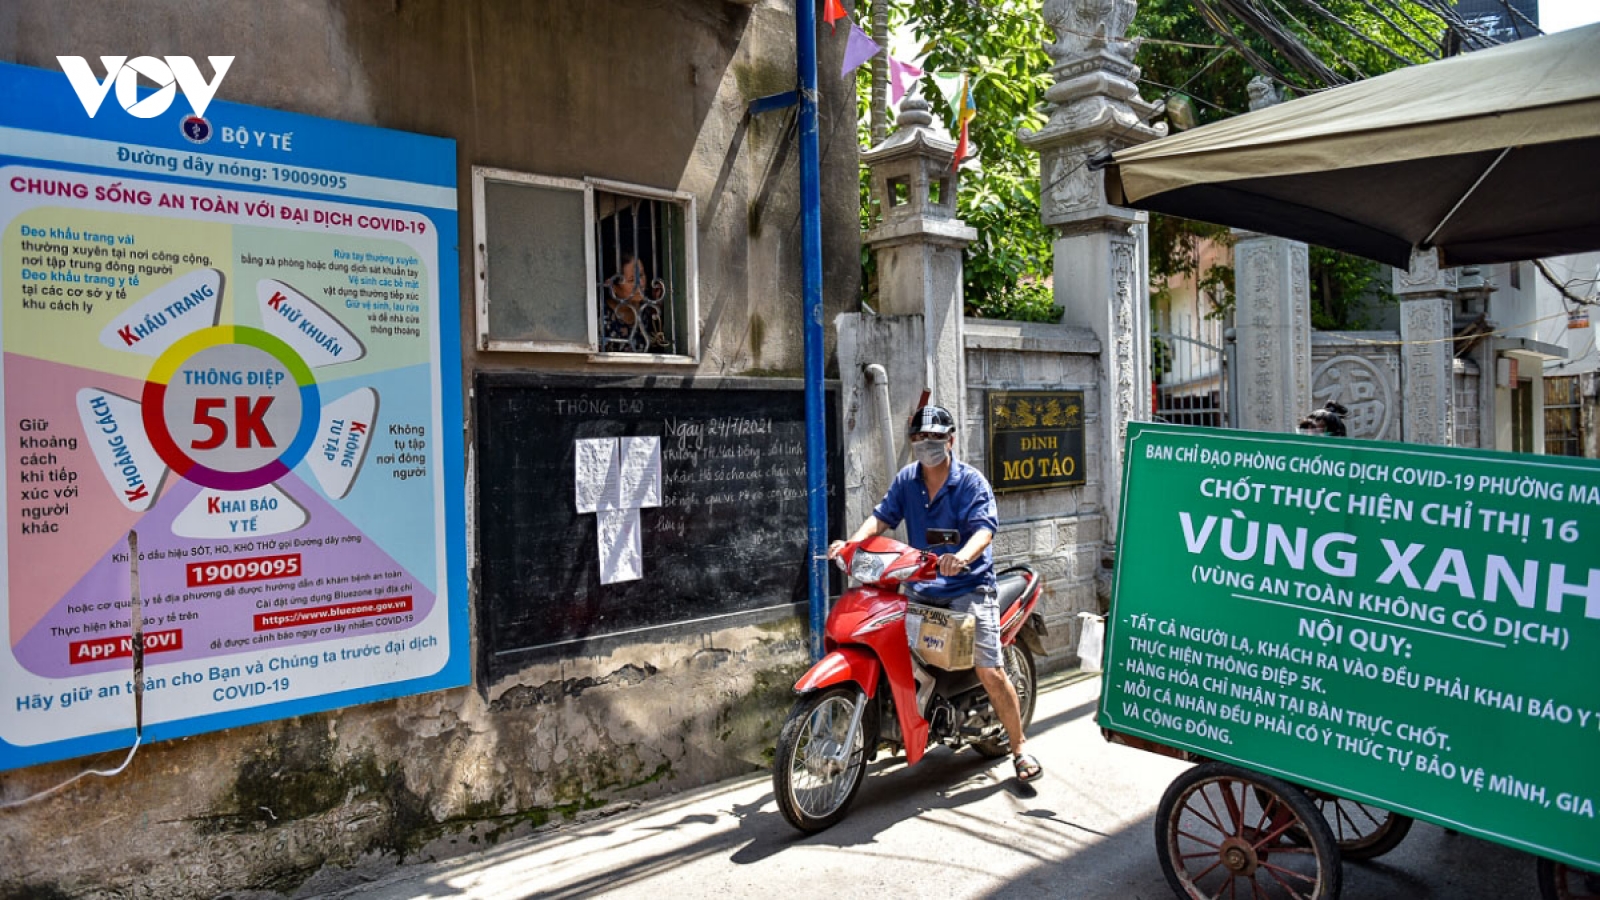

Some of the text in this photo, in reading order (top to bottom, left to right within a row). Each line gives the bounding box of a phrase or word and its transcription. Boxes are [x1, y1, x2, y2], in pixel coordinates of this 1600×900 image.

[222, 126, 292, 151] BỘ Y TẾ
[116, 146, 347, 189] Đường dây nóng: 19009095
[10, 176, 426, 234] CHUNG SỐNG AN TOÀN VỚI ĐẠI DỊCH COVID-19
[21, 225, 46, 238] Đeo
[50, 228, 80, 240] khẩu
[83, 232, 114, 246] trang
[21, 240, 212, 266] thường xuyên tại nơi công cộng,
[22, 256, 43, 266] nơi
[46, 257, 66, 270] tập
[69, 258, 102, 272] trung
[138, 265, 172, 276] người
[21, 269, 139, 288] Đeo khẩu trang y tế
[117, 284, 214, 347] KHẨU TRANG
[267, 291, 343, 357] KHỬ KHUẨN
[183, 368, 285, 390] THÔNG ĐIỆP
[19, 419, 49, 431] Giữ
[191, 396, 277, 450] 5K
[19, 435, 77, 449] khoảng
[89, 396, 149, 502] KHOẢNG CÁCH
[341, 421, 367, 468] KHÔNG
[1020, 435, 1057, 451] ĐÌNH
[20, 452, 57, 465] cách
[1003, 451, 1075, 481] MƠ TÁO
[21, 466, 77, 483] khi tiếp
[1146, 444, 1173, 460] BAN
[1175, 444, 1198, 463] CHỈ
[1200, 448, 1231, 469] ĐẠO
[1234, 451, 1286, 471] PHÒNG
[1289, 454, 1345, 477] CHỐNG
[1349, 463, 1389, 484] DỊCH
[1392, 467, 1475, 491] COVID-19
[1479, 476, 1563, 501] PHƯỜNG
[21, 486, 78, 500] xúc với
[207, 494, 278, 514] KHAI BÁO
[22, 503, 69, 520] người
[1200, 476, 1578, 542] CHỐT THỰC HIỆN CHỈ THỊ 16
[22, 521, 59, 534] khác
[228, 515, 258, 532] Y TẾ
[192, 558, 298, 583] 19009095
[1179, 509, 1600, 619] VÙNG XANH
[262, 601, 406, 626] https://www.bluezone.gov.vn
[1192, 564, 1568, 650] (VÙNG AN TOÀN KHÔNG CÓ DỊCH)
[78, 643, 115, 659] App
[1299, 618, 1412, 658] NỘI QUY:
[16, 694, 54, 712] Hãy
[60, 686, 93, 708] giữ
[98, 685, 120, 698] an
[172, 672, 203, 686] cho
[209, 667, 240, 682] Bạn
[245, 660, 263, 675] và
[269, 655, 318, 671] Chúng
[323, 652, 336, 663] ta
[341, 644, 380, 660] trước
[385, 639, 405, 655] đại
[409, 635, 437, 651] dịch
[1130, 636, 1326, 694] THỰC HIỆN THÔNG ĐIỆP 5K.
[1132, 613, 1154, 632] TẤT
[1158, 619, 1176, 636] CẢ
[1180, 625, 1228, 647] NGƯỜI
[1231, 635, 1253, 656] LẠ,
[1258, 640, 1313, 668] KHÁCH
[1316, 653, 1338, 671] RA
[1343, 658, 1378, 679] VÀO
[1382, 666, 1420, 688] ĐỀU
[1424, 676, 1469, 700] PHẢI
[1474, 687, 1522, 712] KHAI
[1528, 699, 1572, 723] BÁO
[1578, 709, 1591, 727] Y
[212, 675, 290, 702] COVID-19
[1126, 658, 1451, 751] HÀNG HÓA CHỈ NHẬN TẠI BÀN TRỰC CHỐT.
[1122, 702, 1233, 745] VÀ CỘNG ĐỒNG.
[1124, 680, 1593, 818] MỖI CÁ NHÂN ĐỀU PHẢI CÓ Ý THỨC TỰ BẢO VỆ MÌNH, GIA
